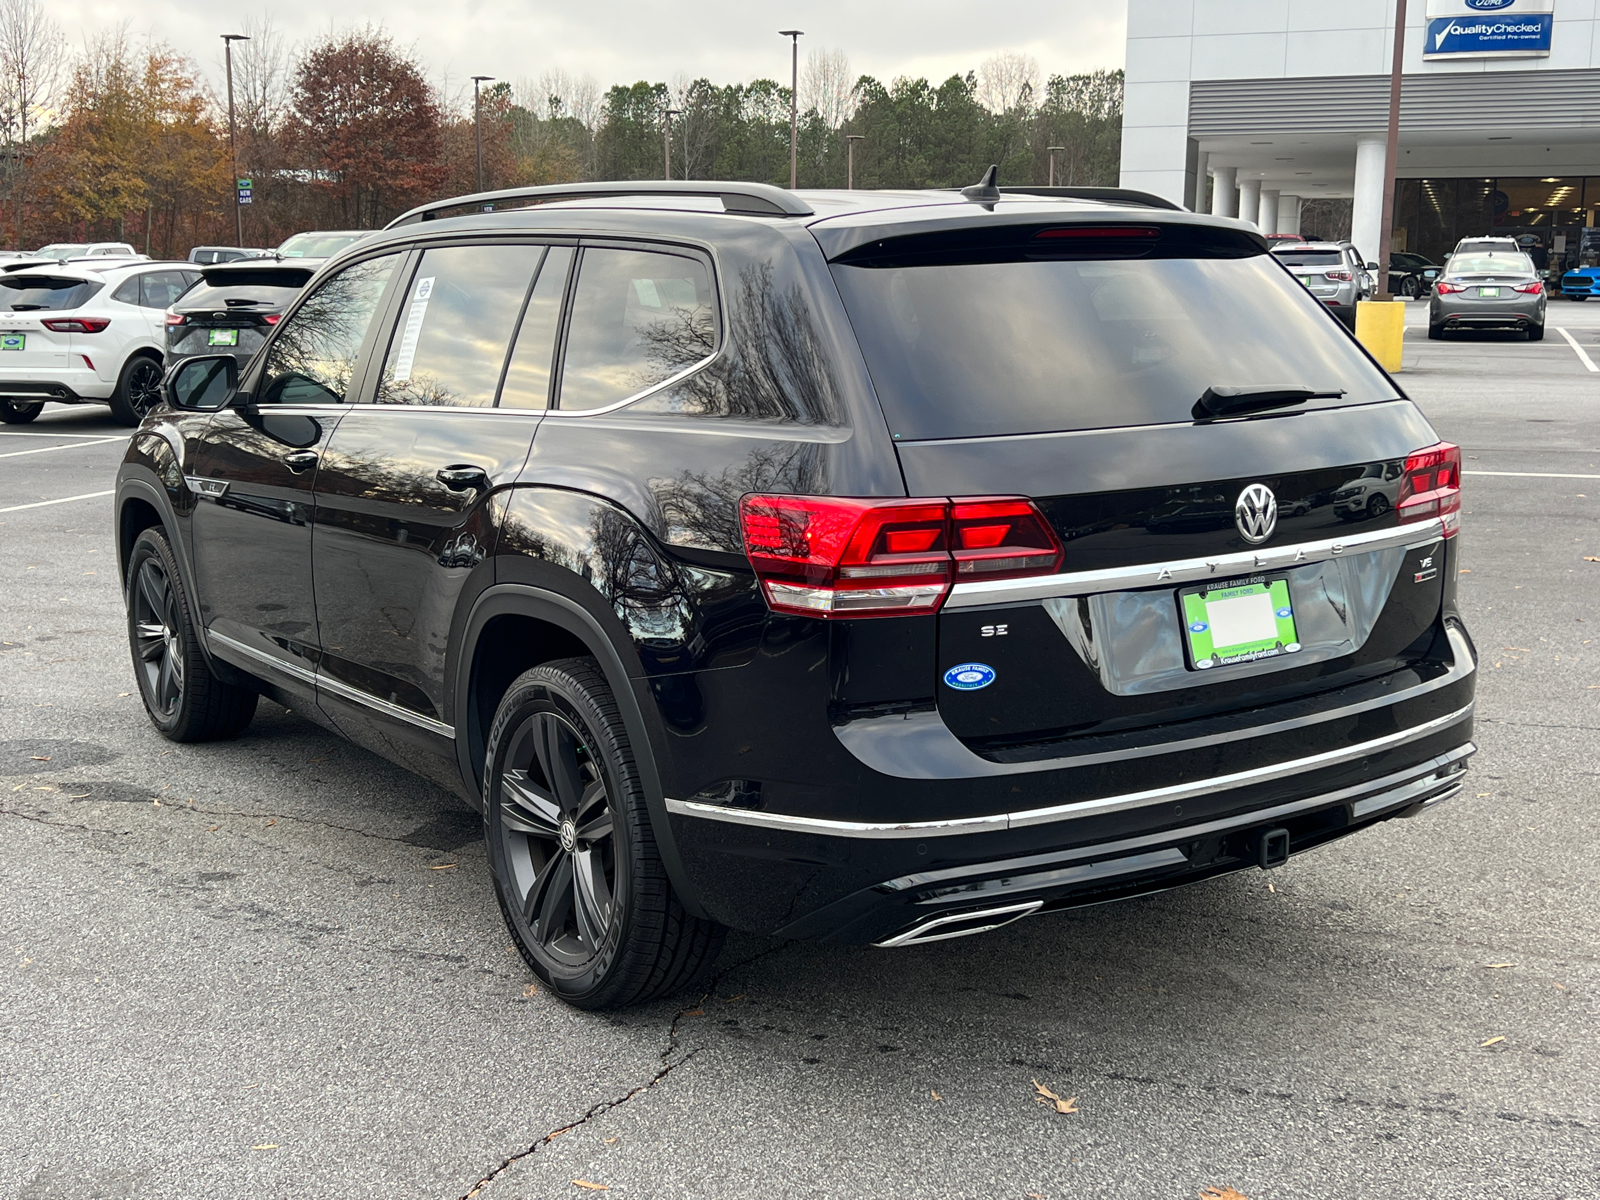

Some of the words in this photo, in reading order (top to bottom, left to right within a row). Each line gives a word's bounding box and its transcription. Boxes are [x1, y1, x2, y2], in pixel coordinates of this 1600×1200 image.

[1450, 23, 1541, 36] QualityChecked
[1157, 541, 1344, 581] ATLAS
[1206, 580, 1229, 591] KRAUSE
[1229, 578, 1250, 588] FAMILY
[1250, 576, 1266, 584] FORD
[1221, 590, 1239, 598] FAMILY
[981, 624, 1008, 637] SE
[591, 900, 624, 985] KELLY
